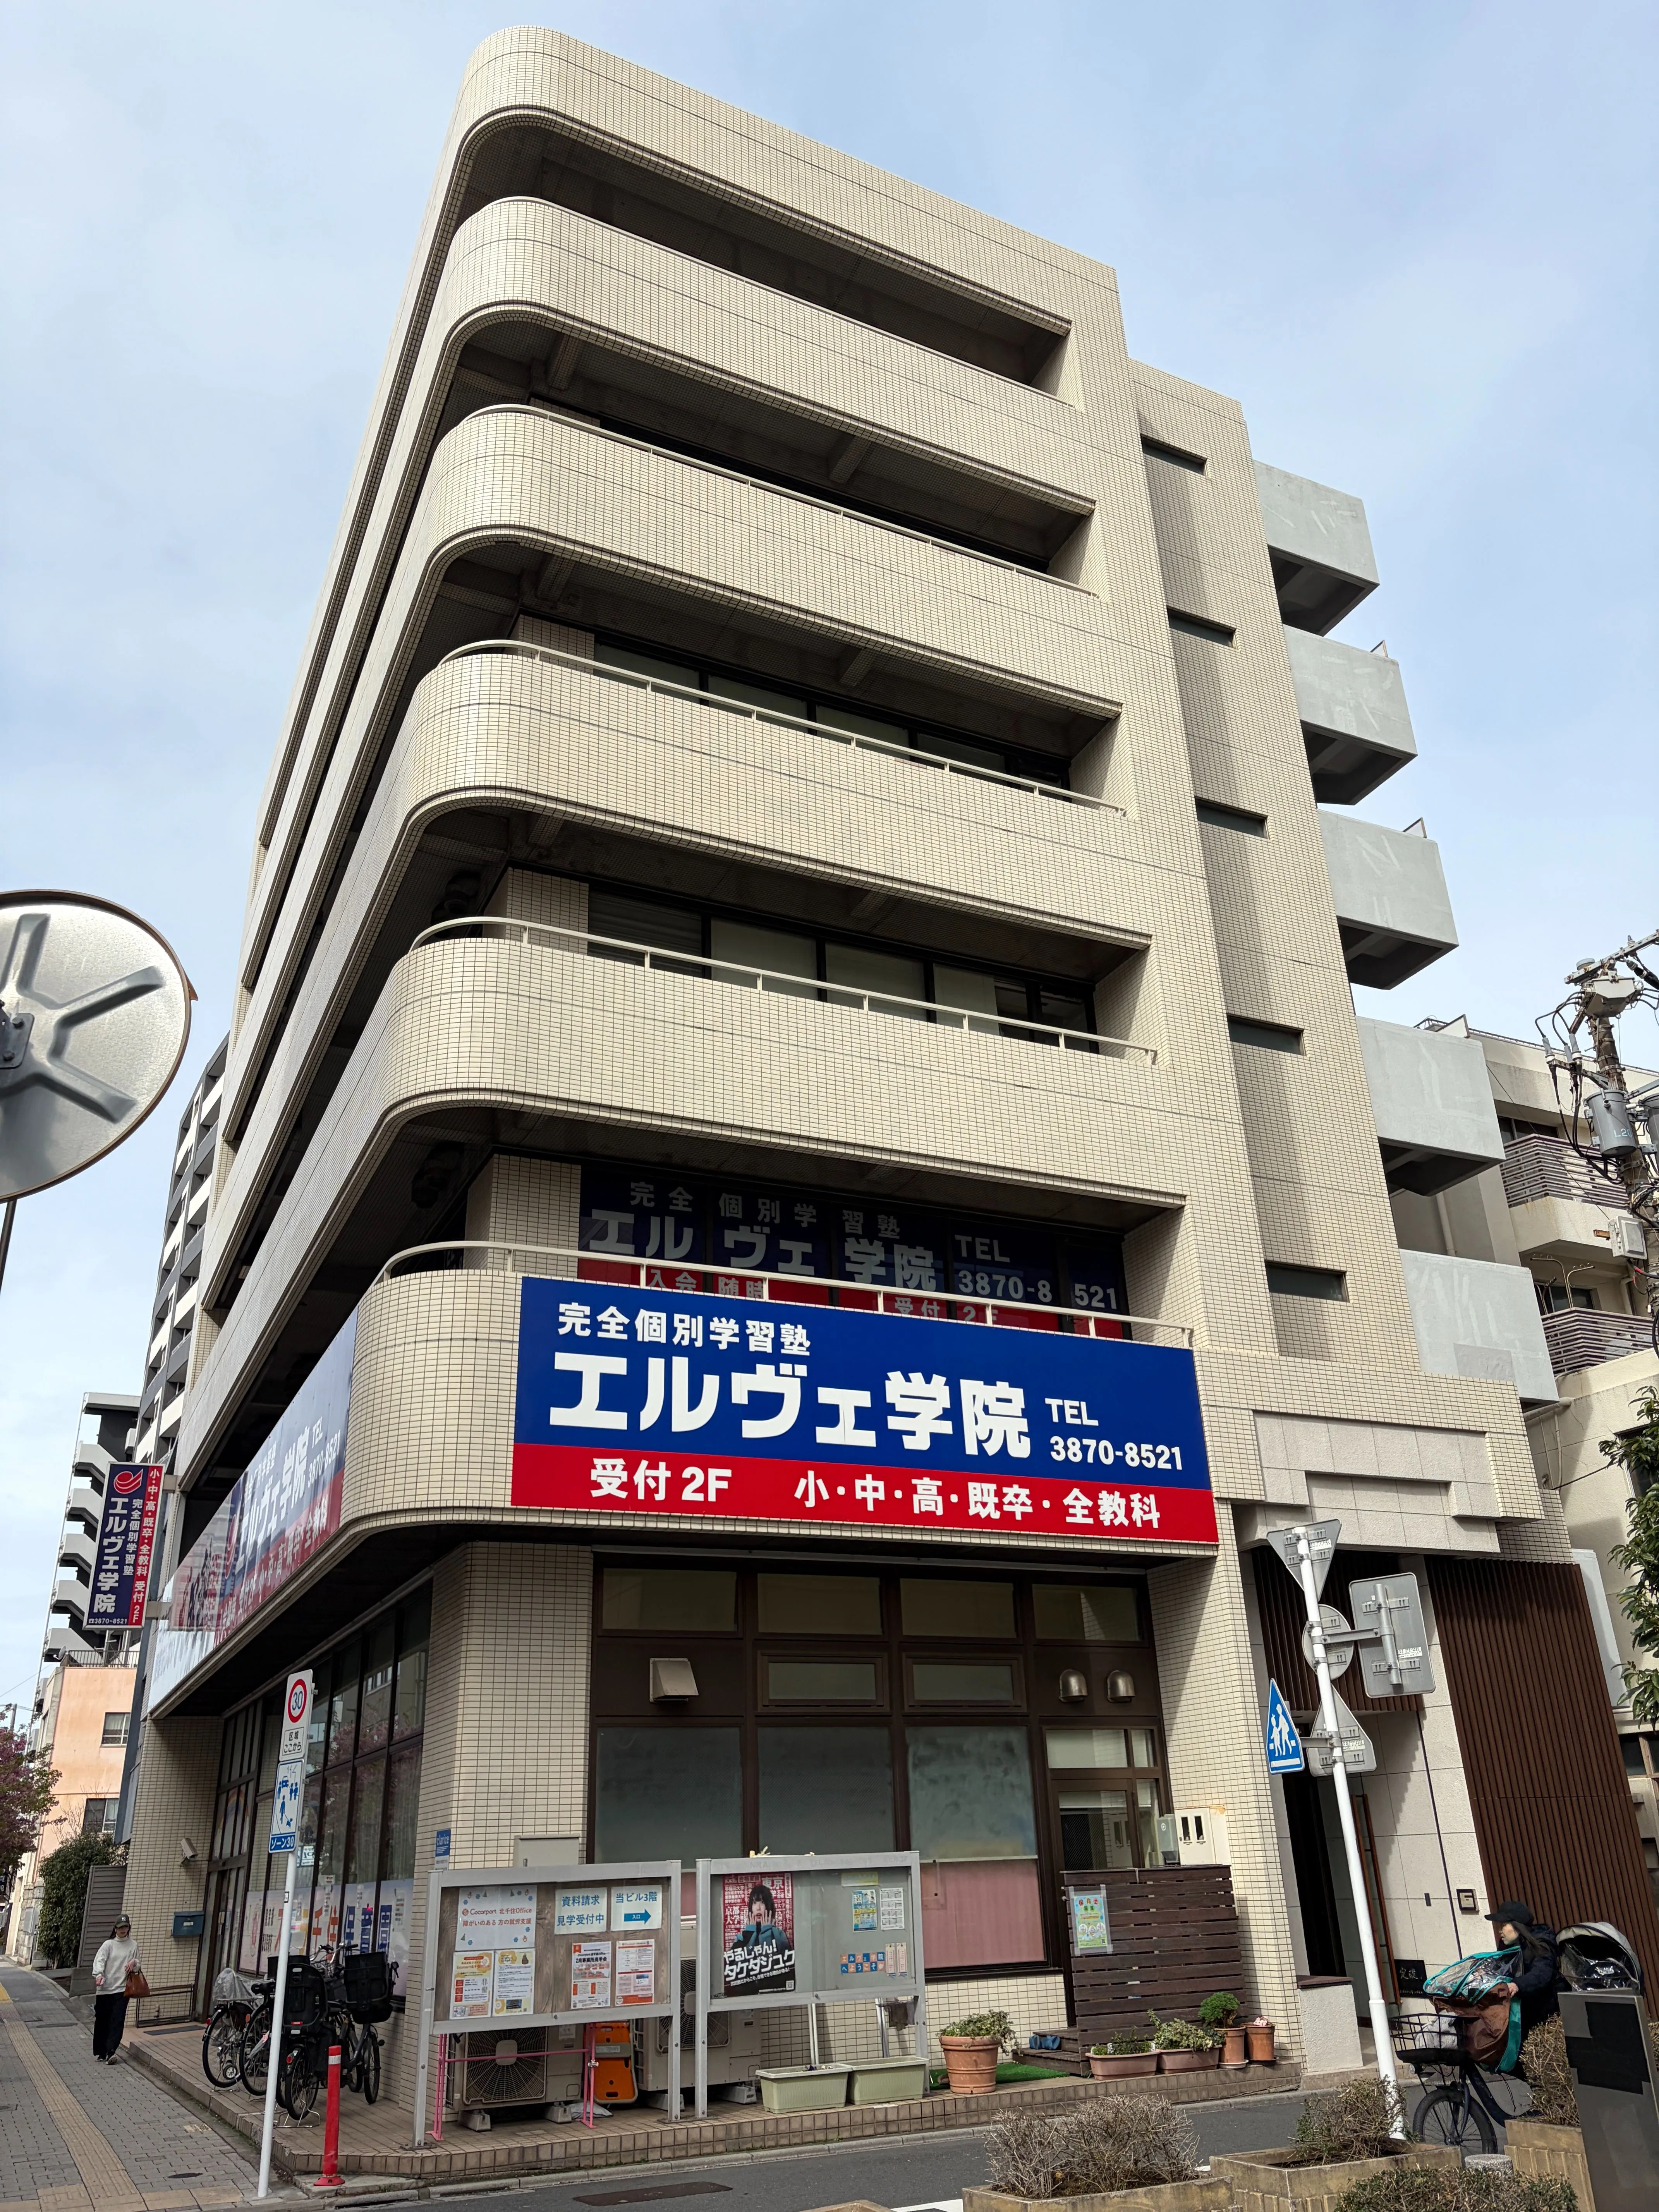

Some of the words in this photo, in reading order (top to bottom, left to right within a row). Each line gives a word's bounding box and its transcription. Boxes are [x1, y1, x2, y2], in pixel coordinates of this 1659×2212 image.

[630, 1181, 900, 1239] 完全個別学習塾
[589, 1208, 936, 1292] エルヴェ学院
[955, 1234, 1010, 1263] TEL
[557, 1302, 811, 1357] 完全個別学習塾
[550, 1352, 1031, 1459] エルヴェ学院
[1044, 1398, 1099, 1427] TEL
[311, 1416, 323, 1449] TEL
[307, 1429, 341, 1489] 3870-8521
[1050, 1435, 1183, 1471] 3870-8521
[122, 1498, 143, 1576] 完全個別学習塾
[93, 1497, 129, 1614] エルヴェ学院
[292, 1690, 303, 1711] 30
[283, 1741, 301, 1753] ここから
[562, 1894, 600, 1907] 資料請求
[615, 1891, 658, 1903] 当ビル3階
[557, 1913, 604, 1926] 見学受付中
